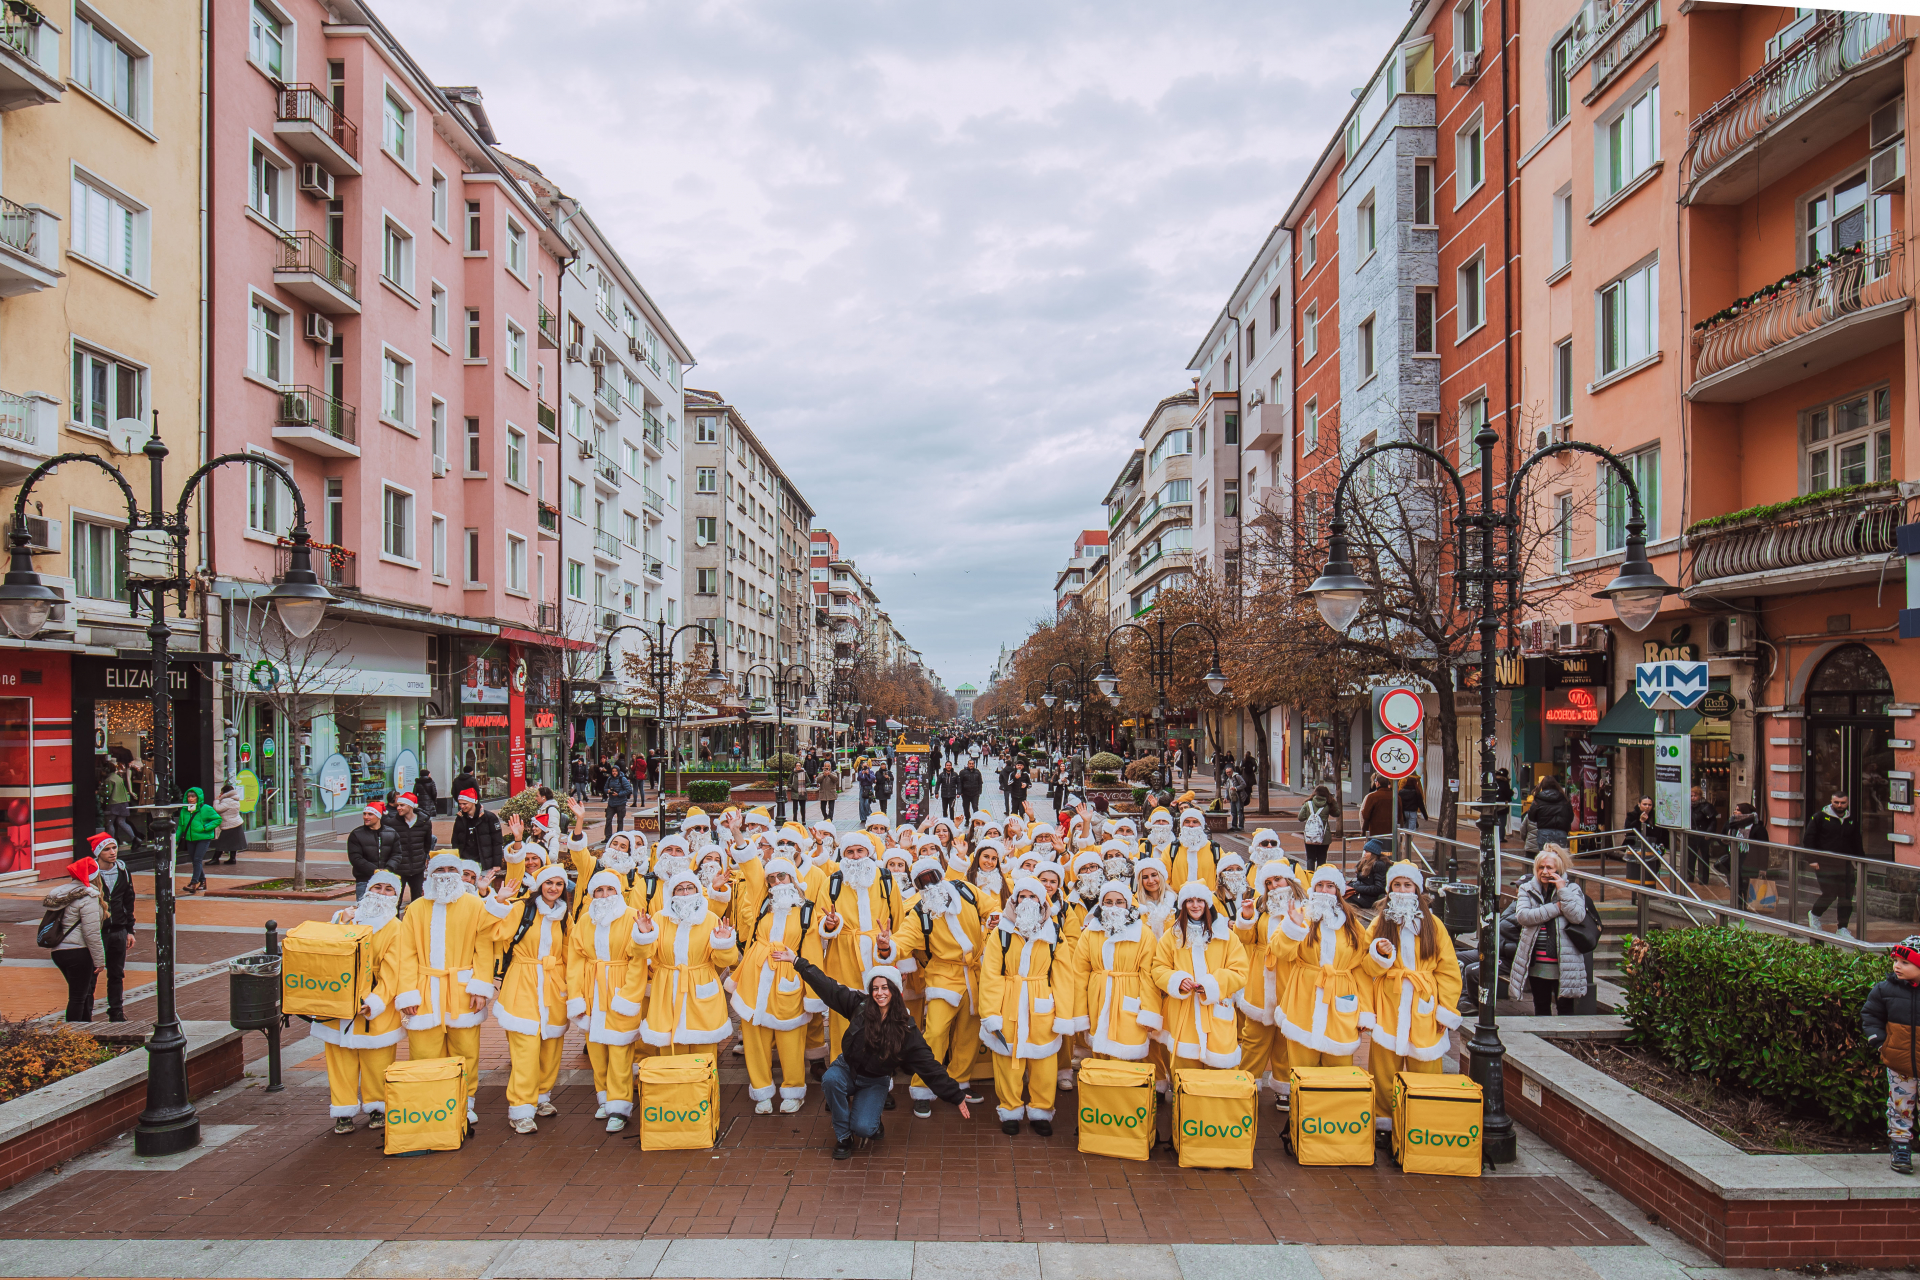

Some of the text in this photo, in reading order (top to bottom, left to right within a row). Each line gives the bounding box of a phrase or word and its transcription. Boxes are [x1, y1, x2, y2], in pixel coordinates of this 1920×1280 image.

[106, 668, 187, 689] ELIZATH
[1705, 698, 1728, 708] Rois
[465, 715, 509, 728] КНИЖАРНИЦА
[1546, 710, 1576, 720] ALCOHOL
[285, 973, 342, 993] Glovo
[388, 1108, 448, 1125] Glovo
[644, 1106, 701, 1123] Glovo
[1080, 1107, 1138, 1129] Glovo
[1183, 1119, 1243, 1139] Glovo
[1302, 1116, 1362, 1136] Glovo
[1408, 1128, 1470, 1148] Glovo
